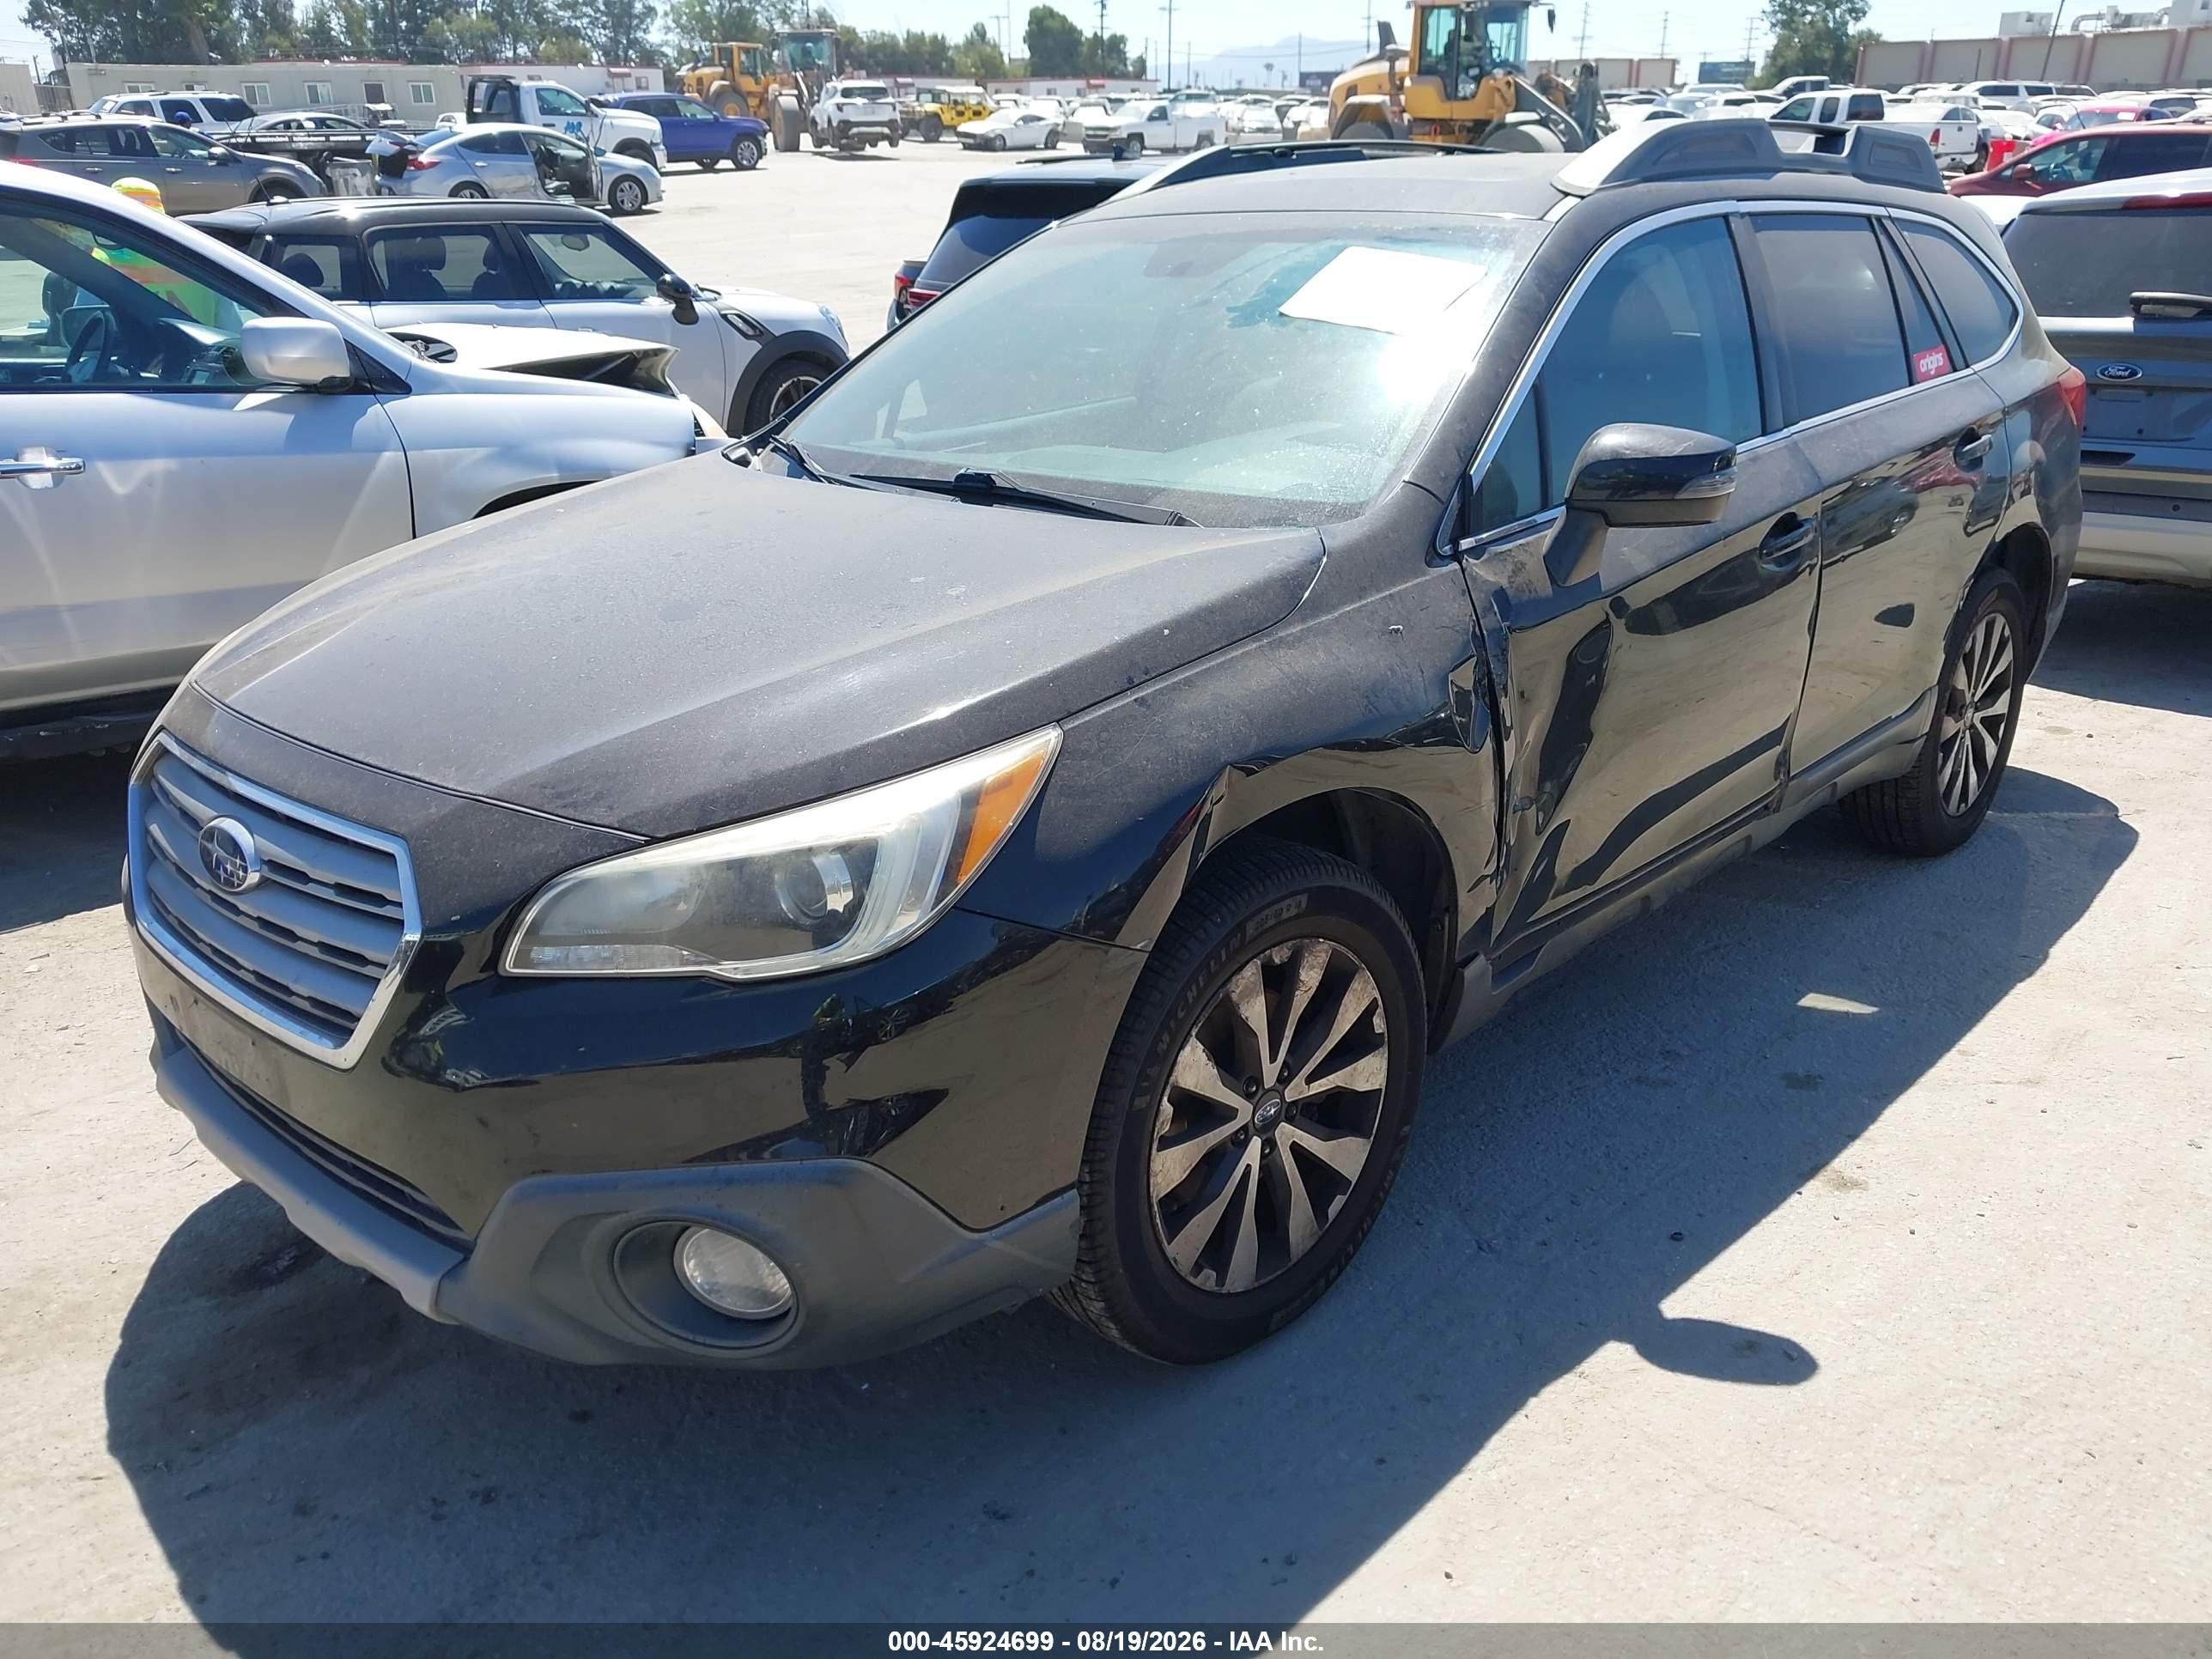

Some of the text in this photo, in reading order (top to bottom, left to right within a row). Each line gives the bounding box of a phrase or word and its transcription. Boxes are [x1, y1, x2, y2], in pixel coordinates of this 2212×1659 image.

[1919, 350, 1944, 375] origins
[2103, 364, 2132, 378] Ford
[1156, 931, 1243, 1056] MICHELIN
